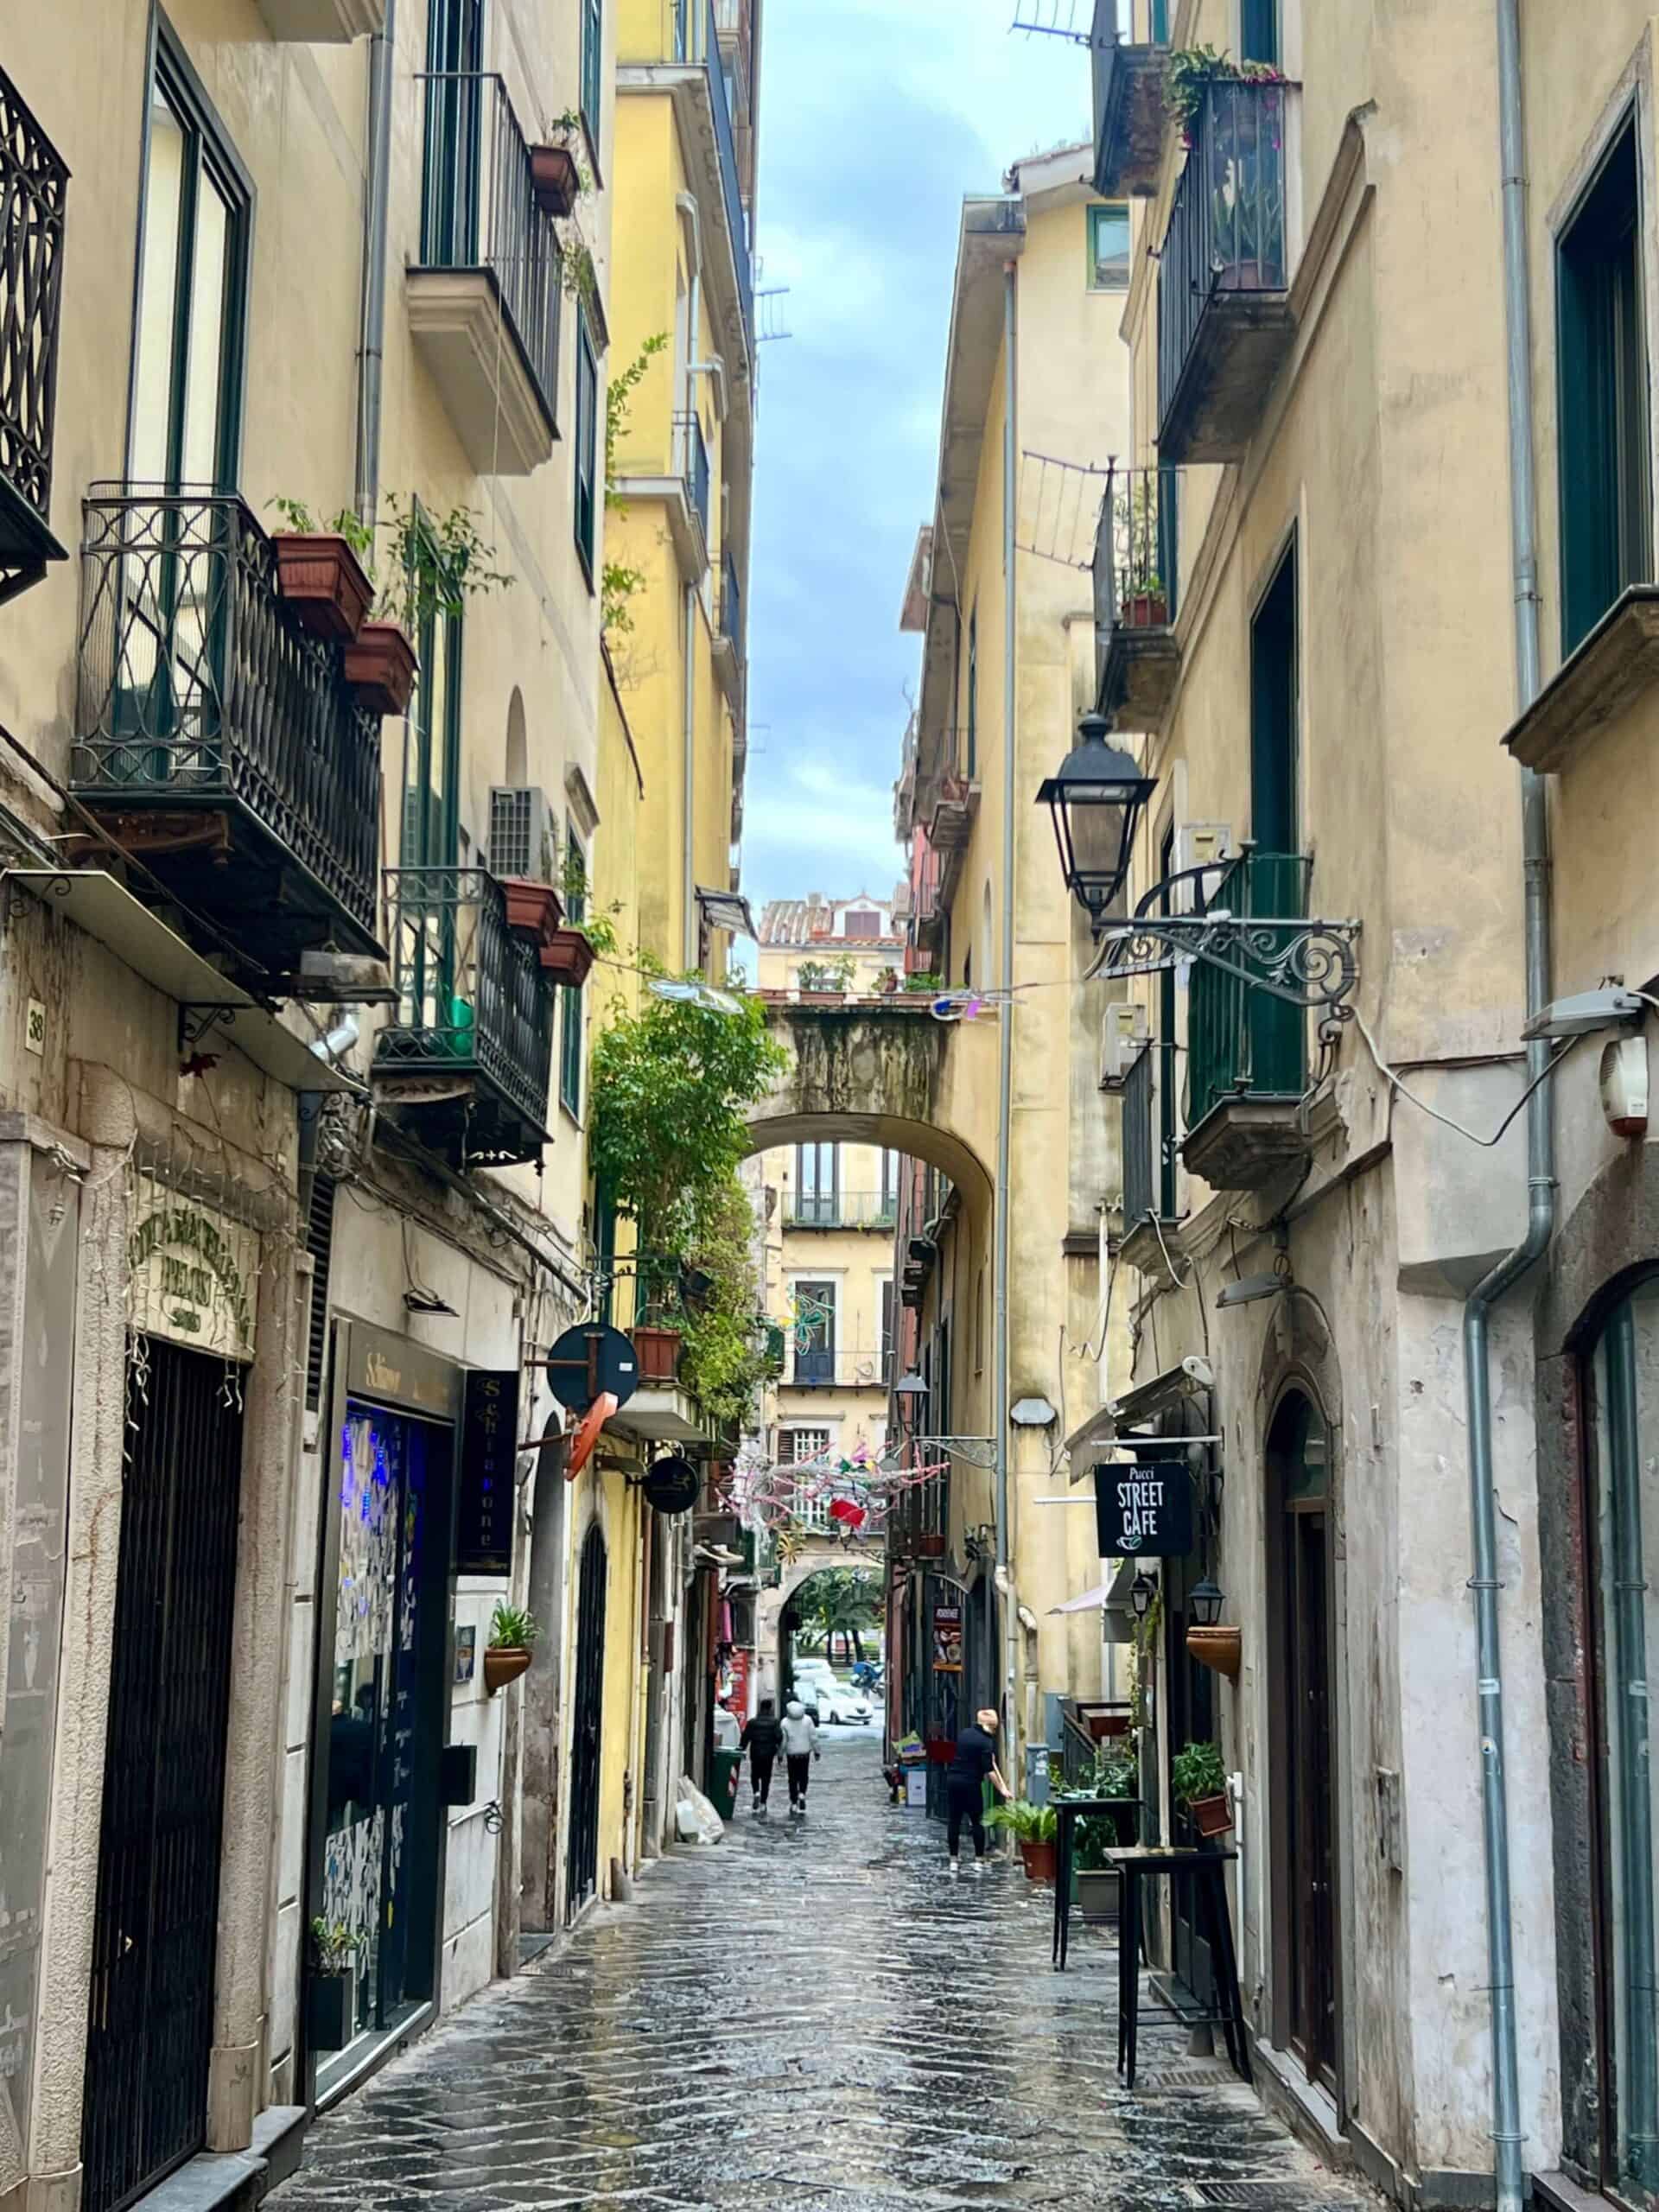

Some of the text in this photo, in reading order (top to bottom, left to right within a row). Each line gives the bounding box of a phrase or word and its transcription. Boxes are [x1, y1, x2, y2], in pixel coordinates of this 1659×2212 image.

[29, 1009, 42, 1042] 38
[1129, 1465, 1154, 1480] Pucci
[1117, 1481, 1164, 1508] STREET
[1122, 1510, 1158, 1535] CAFE
